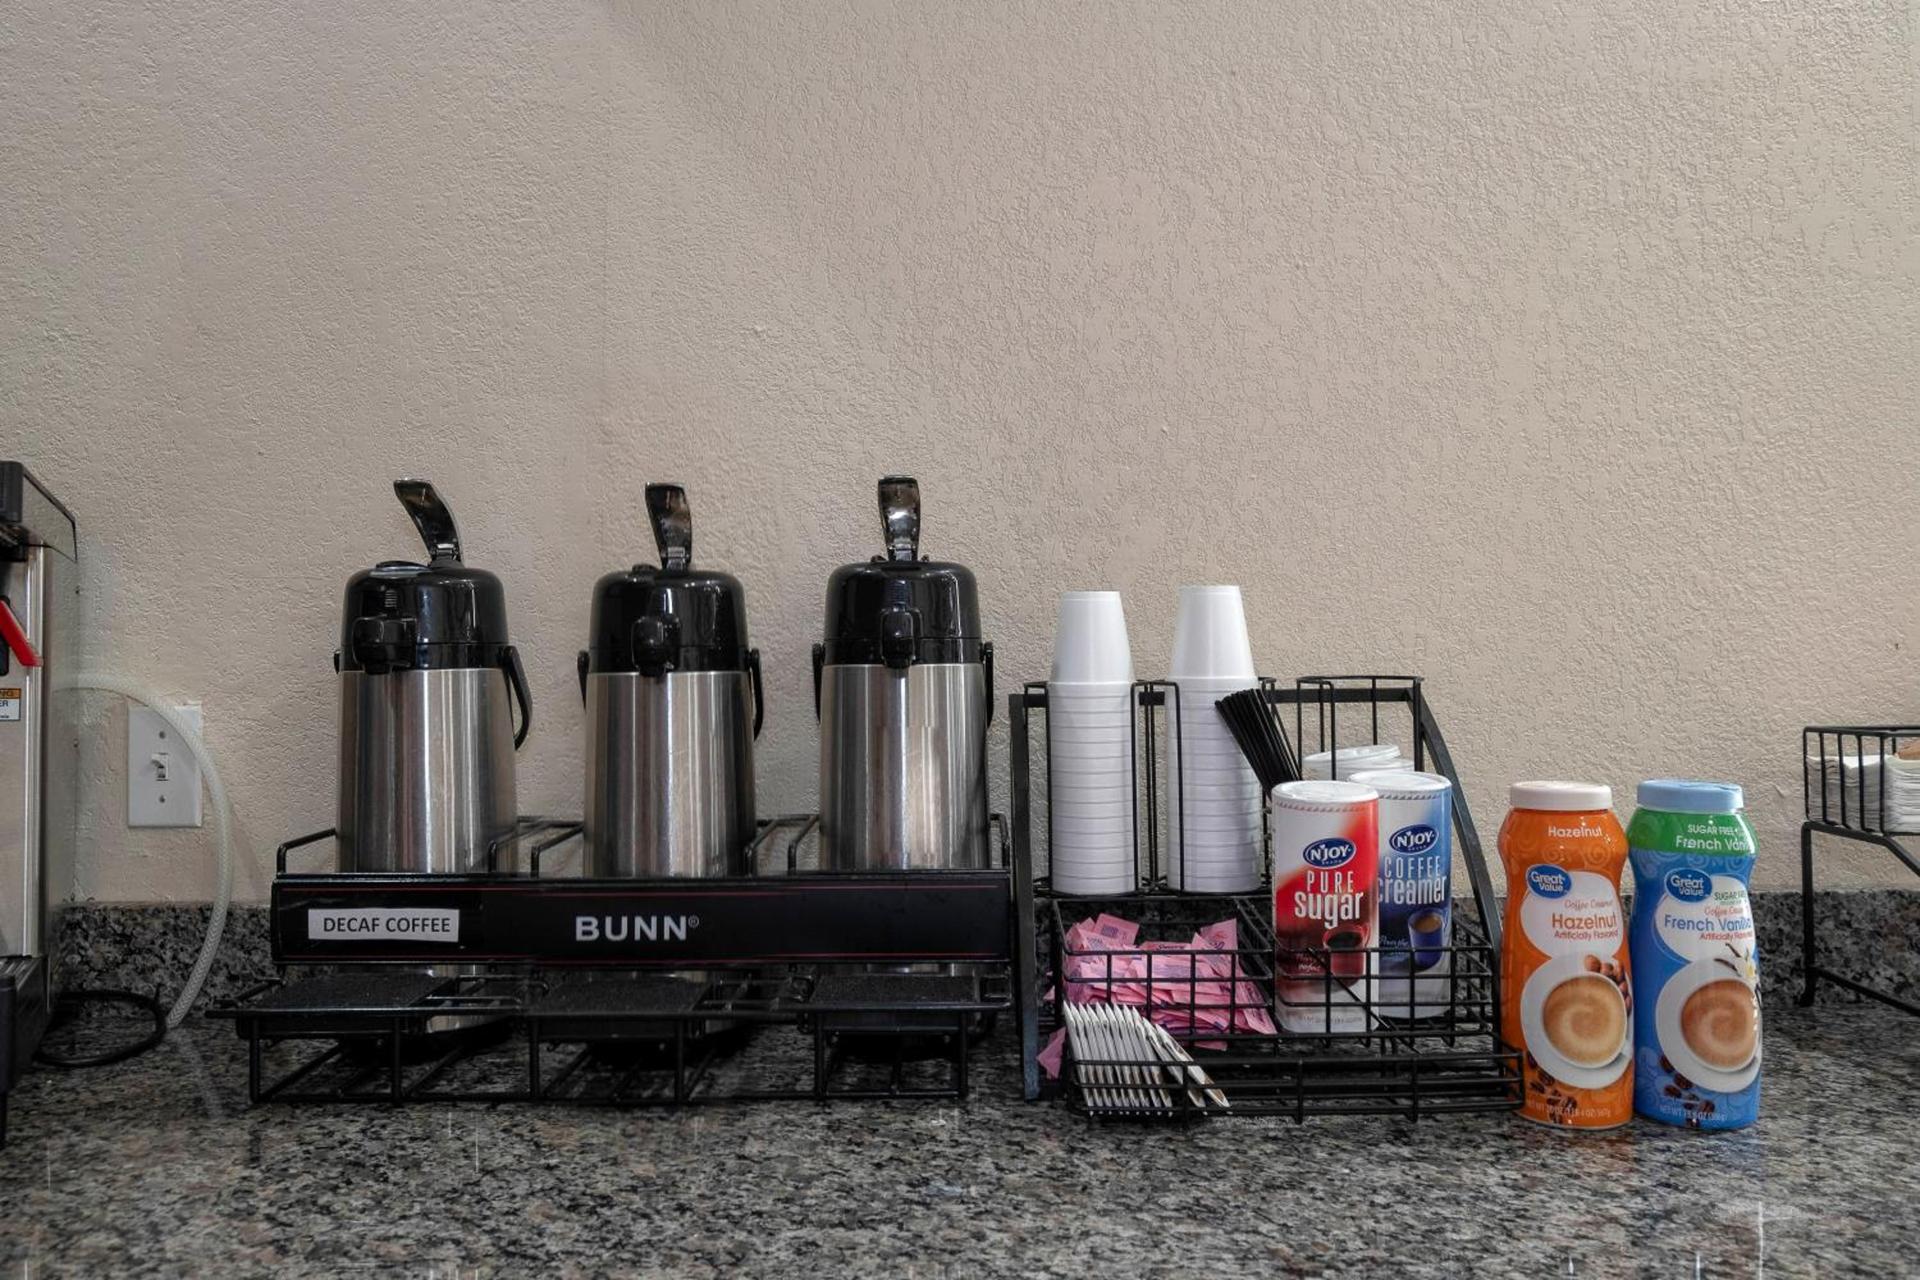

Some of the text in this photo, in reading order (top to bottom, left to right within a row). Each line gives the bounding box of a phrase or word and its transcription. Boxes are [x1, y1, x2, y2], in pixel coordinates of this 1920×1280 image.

[1547, 825, 1603, 838] Hazelnut
[1687, 824, 1718, 835] SUGAR
[1675, 835, 1722, 850] French
[1384, 855, 1441, 879] COFFEE
[1306, 870, 1354, 894] PURE
[1530, 871, 1565, 885] Great
[1670, 874, 1704, 889] Great
[1378, 875, 1447, 905] creamer
[1538, 882, 1564, 892] Value
[1679, 885, 1704, 896] Value
[1294, 891, 1364, 930] sugar
[323, 917, 451, 933] DECAF COFFEE
[1552, 910, 1618, 930] Hazelnut
[1664, 914, 1715, 932] French
